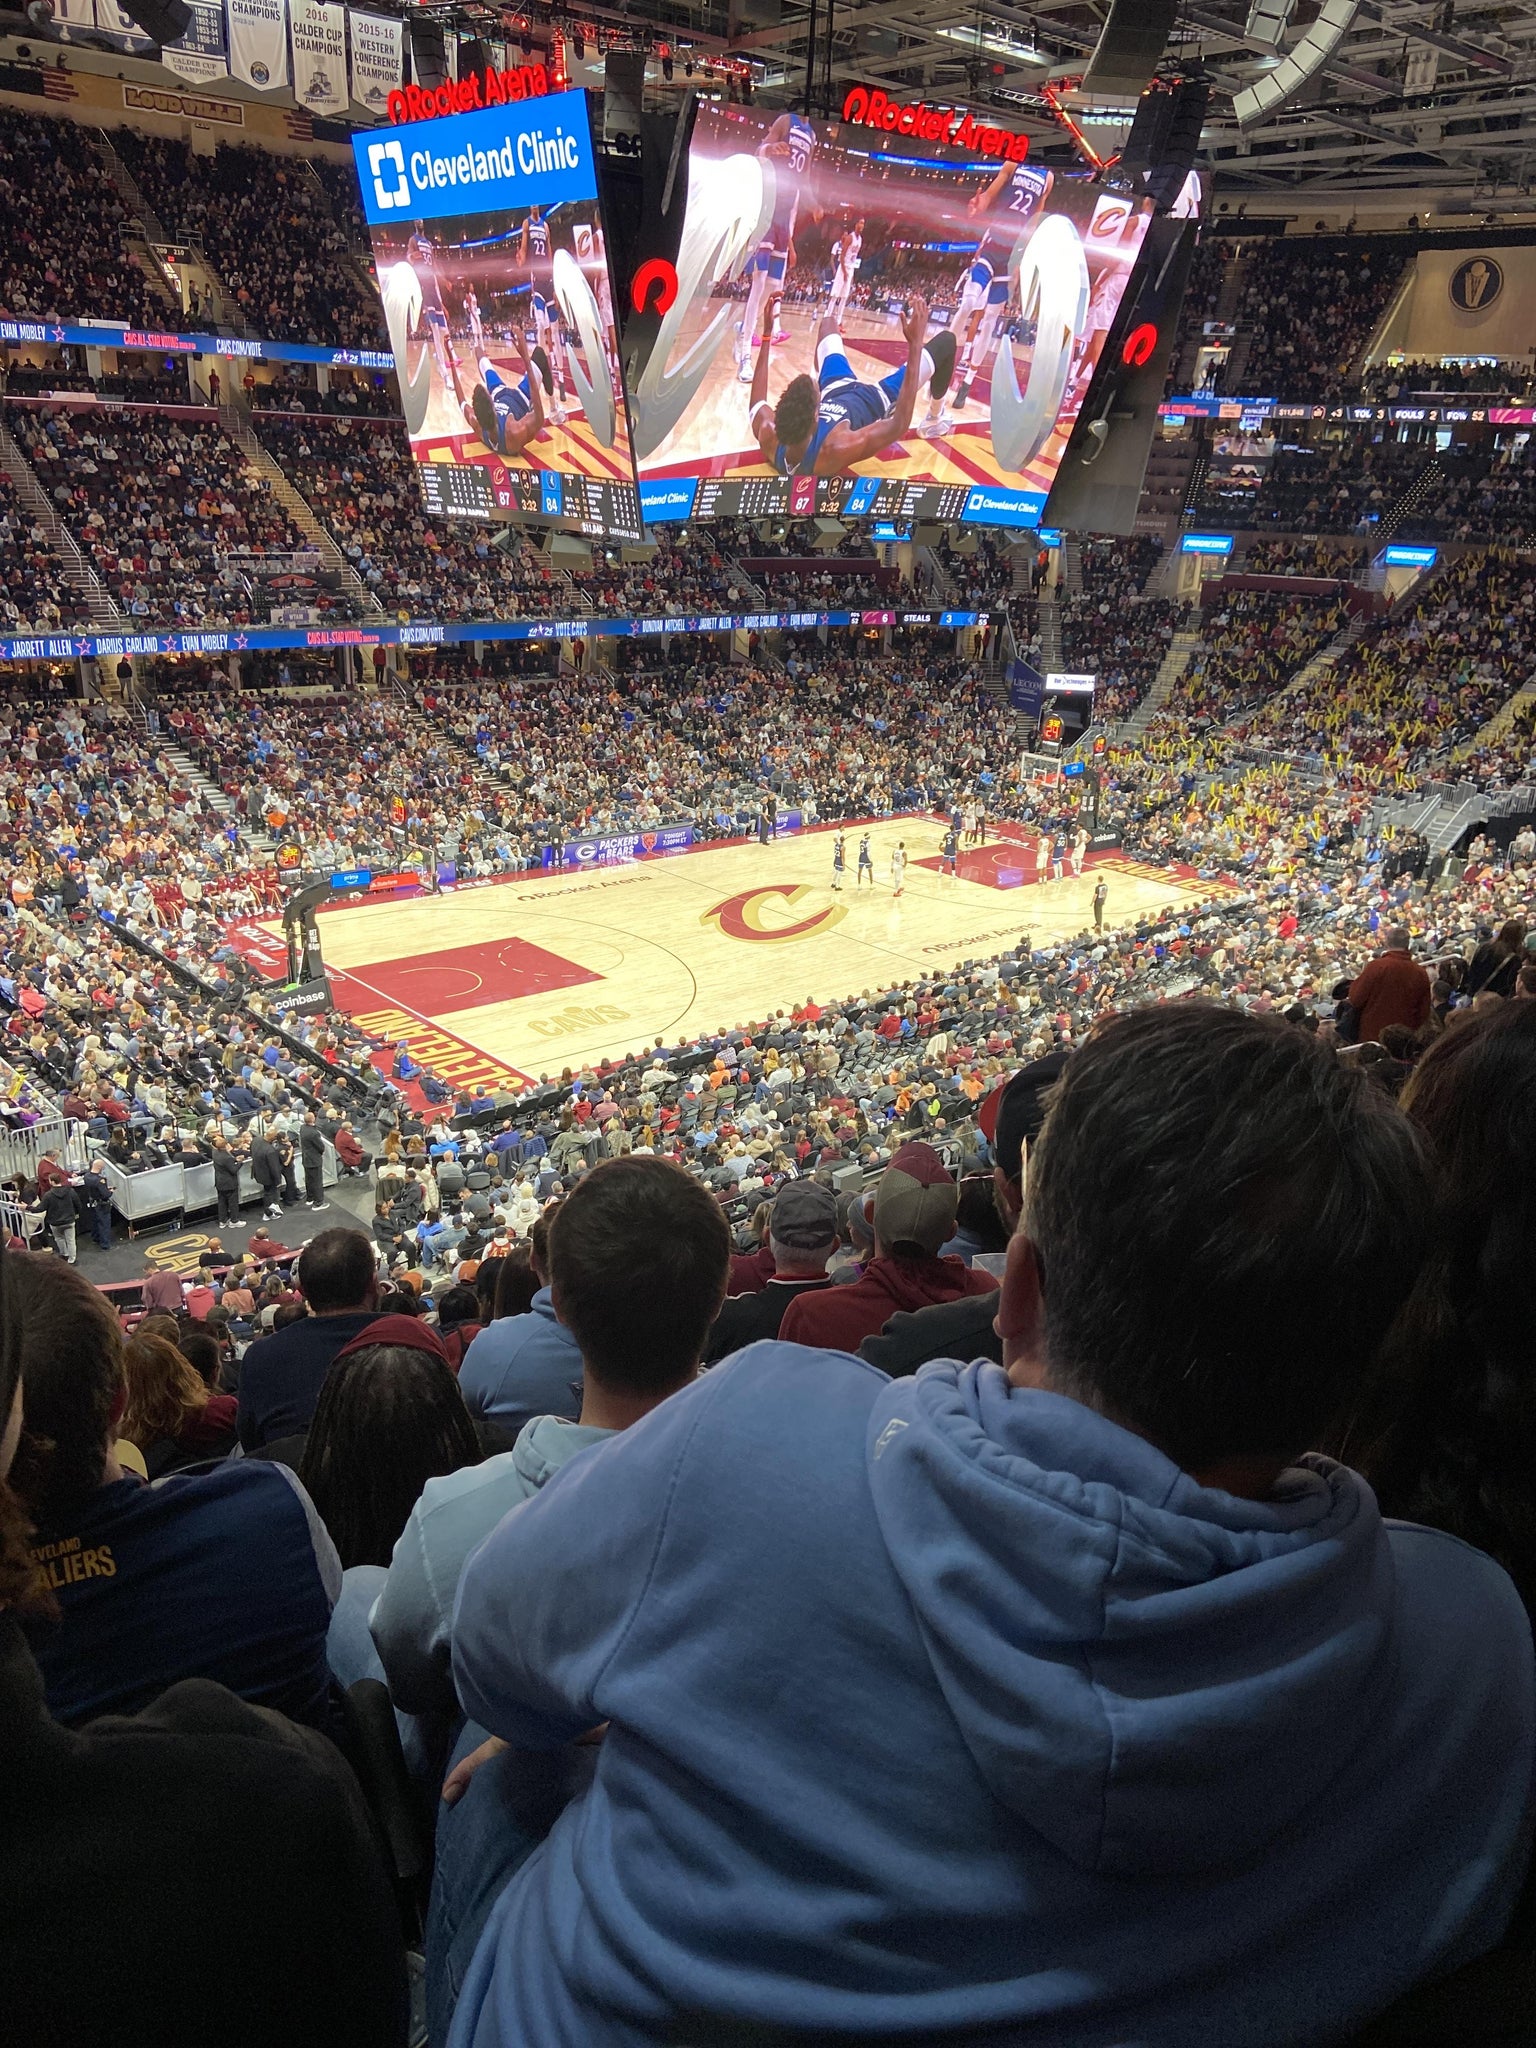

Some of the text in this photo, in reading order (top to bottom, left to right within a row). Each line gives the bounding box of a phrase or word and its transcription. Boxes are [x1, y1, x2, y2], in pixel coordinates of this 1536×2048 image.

[232, 1, 281, 20] CHAMPIONS
[305, 8, 328, 22] 2016
[293, 22, 343, 42] CALDER CUP
[358, 22, 395, 39] 2015-16
[295, 37, 343, 56] CHAMPIONS
[360, 38, 395, 55] WESTERN
[173, 57, 217, 70] CALDER CUP
[354, 51, 400, 69] CONFERENCE
[174, 65, 217, 77] CHAMPIONS
[357, 65, 399, 83] CHAMPIONS
[405, 63, 548, 121] Rocket Arena
[124, 86, 243, 125] LOUDVILLE
[866, 89, 1029, 162] Rocket Arena
[410, 127, 579, 190] Cleveland Clinic
[788, 148, 806, 173] 30
[1012, 175, 1043, 197] MINNESOTA
[1009, 190, 1033, 216] 22
[533, 239, 546, 256] 22
[0, 322, 46, 340] EVAN MOBLEY
[216, 338, 263, 357] CAVS.COM/VOTE
[360, 350, 394, 368] VOTE CAVS
[1354, 409, 1385, 419] TOL 3
[1395, 410, 1437, 420] FOULS 2
[1446, 410, 1485, 421] FG% 52
[843, 480, 853, 489] 24
[499, 491, 510, 506] 87
[521, 499, 538, 512] 3:32
[546, 497, 558, 512] 84
[641, 492, 689, 507] veland Clinic
[795, 497, 810, 510] 87
[851, 498, 865, 511] 84
[982, 498, 1039, 514] Cleveland Clinic
[820, 501, 840, 513] 3:32
[642, 619, 685, 633] DONOVAN MITCHELL
[699, 616, 732, 630] JARRETT ALLEN
[801, 613, 818, 625] MOBLEY
[881, 615, 888, 623] 6
[904, 614, 931, 622] STEALS
[946, 615, 952, 623] 3
[400, 626, 445, 643] CAVS.COM/VOTE
[555, 621, 588, 637] VOTE CAVS
[96, 636, 158, 654] DARIUS GARLAND
[181, 634, 228, 650] EVAN MOBLEY
[321, 631, 344, 644] ALL-STAR
[12, 639, 72, 658] JARRETT ALLEN
[1045, 727, 1059, 738] 24
[600, 835, 639, 850] PACKERS
[663, 831, 687, 840] TONIGHT
[606, 846, 635, 859] BEARS
[533, 876, 653, 899] Rocket Arena
[236, 925, 286, 951] ULTRA
[935, 922, 1043, 951] Rocket Arena
[275, 991, 325, 1010] coinbase
[527, 1004, 632, 1036] CAVS
[351, 1008, 526, 1096] CLEVELAND
